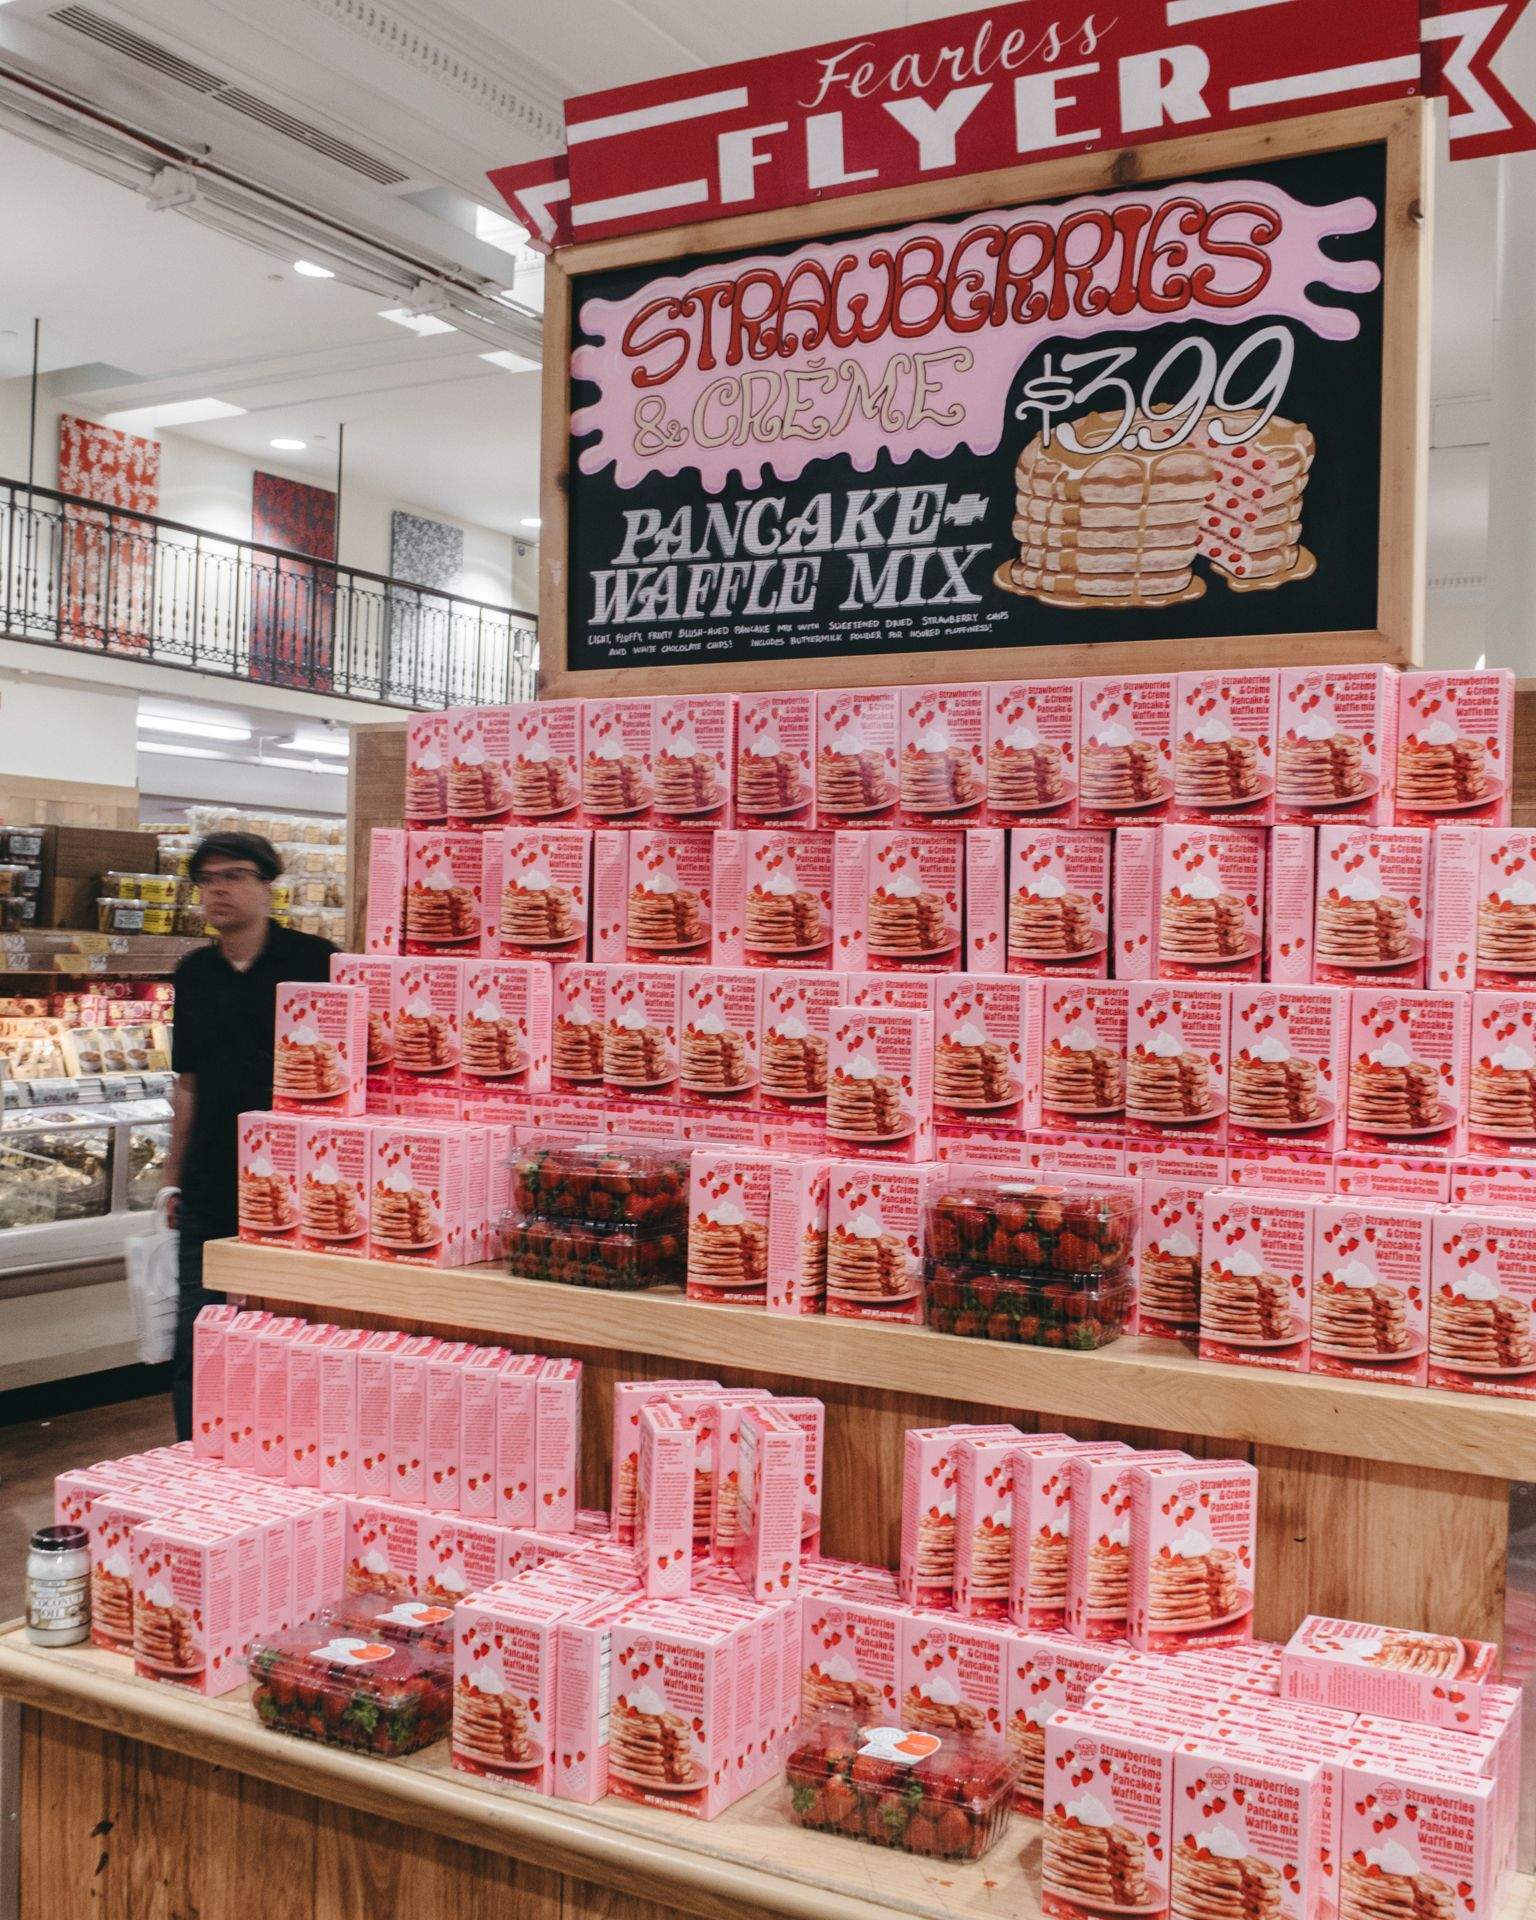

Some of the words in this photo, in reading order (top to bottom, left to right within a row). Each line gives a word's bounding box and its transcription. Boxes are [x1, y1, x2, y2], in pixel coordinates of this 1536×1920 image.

[797, 14, 1118, 107] Fearless
[717, 44, 1212, 204] FLYER
[622, 197, 1283, 388] STRAWBERRIES
[1015, 325, 1295, 456] $3.99
[633, 395, 690, 457] &
[588, 555, 823, 627] WAFFLE
[839, 543, 992, 610] MIX
[734, 625, 770, 634] PANCAKE
[777, 624, 793, 632] MIX
[797, 622, 820, 631] WITH
[828, 619, 880, 631] SWEETENED
[885, 617, 914, 628] DRIED
[922, 613, 979, 626] STRAWBERRY
[986, 611, 1010, 620] CHIPS
[750, 638, 786, 647] INCLUDES
[790, 634, 842, 645] BUTTERMILK
[850, 630, 882, 640] POWDER
[888, 630, 904, 639] FOR
[609, 647, 627, 656] AND
[633, 645, 656, 654] WHITE
[661, 642, 701, 653] CHOCOLATE
[1251, 1205, 1305, 1218] Strawberries
[1365, 1215, 1422, 1229] Strawberries
[1262, 1228, 1297, 1239] Pancake
[1261, 1239, 1288, 1250] Waffle
[1289, 1242, 1304, 1251] mix
[1377, 1239, 1413, 1250] Pancake
[1375, 1250, 1404, 1261] Waffle
[1405, 1254, 1421, 1262] mix
[1200, 1478, 1250, 1489] Strawberries
[1211, 1501, 1243, 1512] Pancake
[1209, 1513, 1234, 1523] Waffle
[1236, 1512, 1249, 1522] mix
[846, 1612, 895, 1630] Strawberries
[494, 1621, 540, 1640] Strawberries
[655, 1640, 705, 1660] Strawberries
[856, 1636, 887, 1650] Pancake
[948, 1632, 999, 1651] Strawberries
[503, 1647, 533, 1661] Pancake
[855, 1645, 879, 1659] Waffle
[881, 1652, 894, 1662] mix
[503, 1658, 525, 1671] Waffle
[526, 1664, 539, 1675] mix
[664, 1666, 697, 1680] Pancake
[959, 1658, 992, 1672] Pancake
[957, 1668, 983, 1682] Waffle
[985, 1674, 999, 1685] mix
[664, 1677, 688, 1691] Waffle
[690, 1683, 704, 1694] mix
[1100, 1744, 1161, 1767] Strawberries
[1123, 1762, 1130, 1773] &
[1113, 1773, 1152, 1790] Pancake
[1154, 1782, 1161, 1793] &
[1233, 1773, 1299, 1796] Strawberries
[1111, 1785, 1142, 1801] Waffle
[1144, 1794, 1161, 1806] mix
[1258, 1792, 1264, 1803] &
[1406, 1789, 1475, 1813] Strawberries
[1247, 1803, 1289, 1822] Pancake
[1291, 1812, 1298, 1823] &
[1431, 1808, 1438, 1819] &
[1245, 1815, 1278, 1832] Waffle
[1280, 1825, 1298, 1837] mix
[1420, 1819, 1464, 1839] Pancake
[1466, 1829, 1473, 1841] &
[1417, 1832, 1452, 1849] Waffle
[1454, 1841, 1473, 1854] mix
